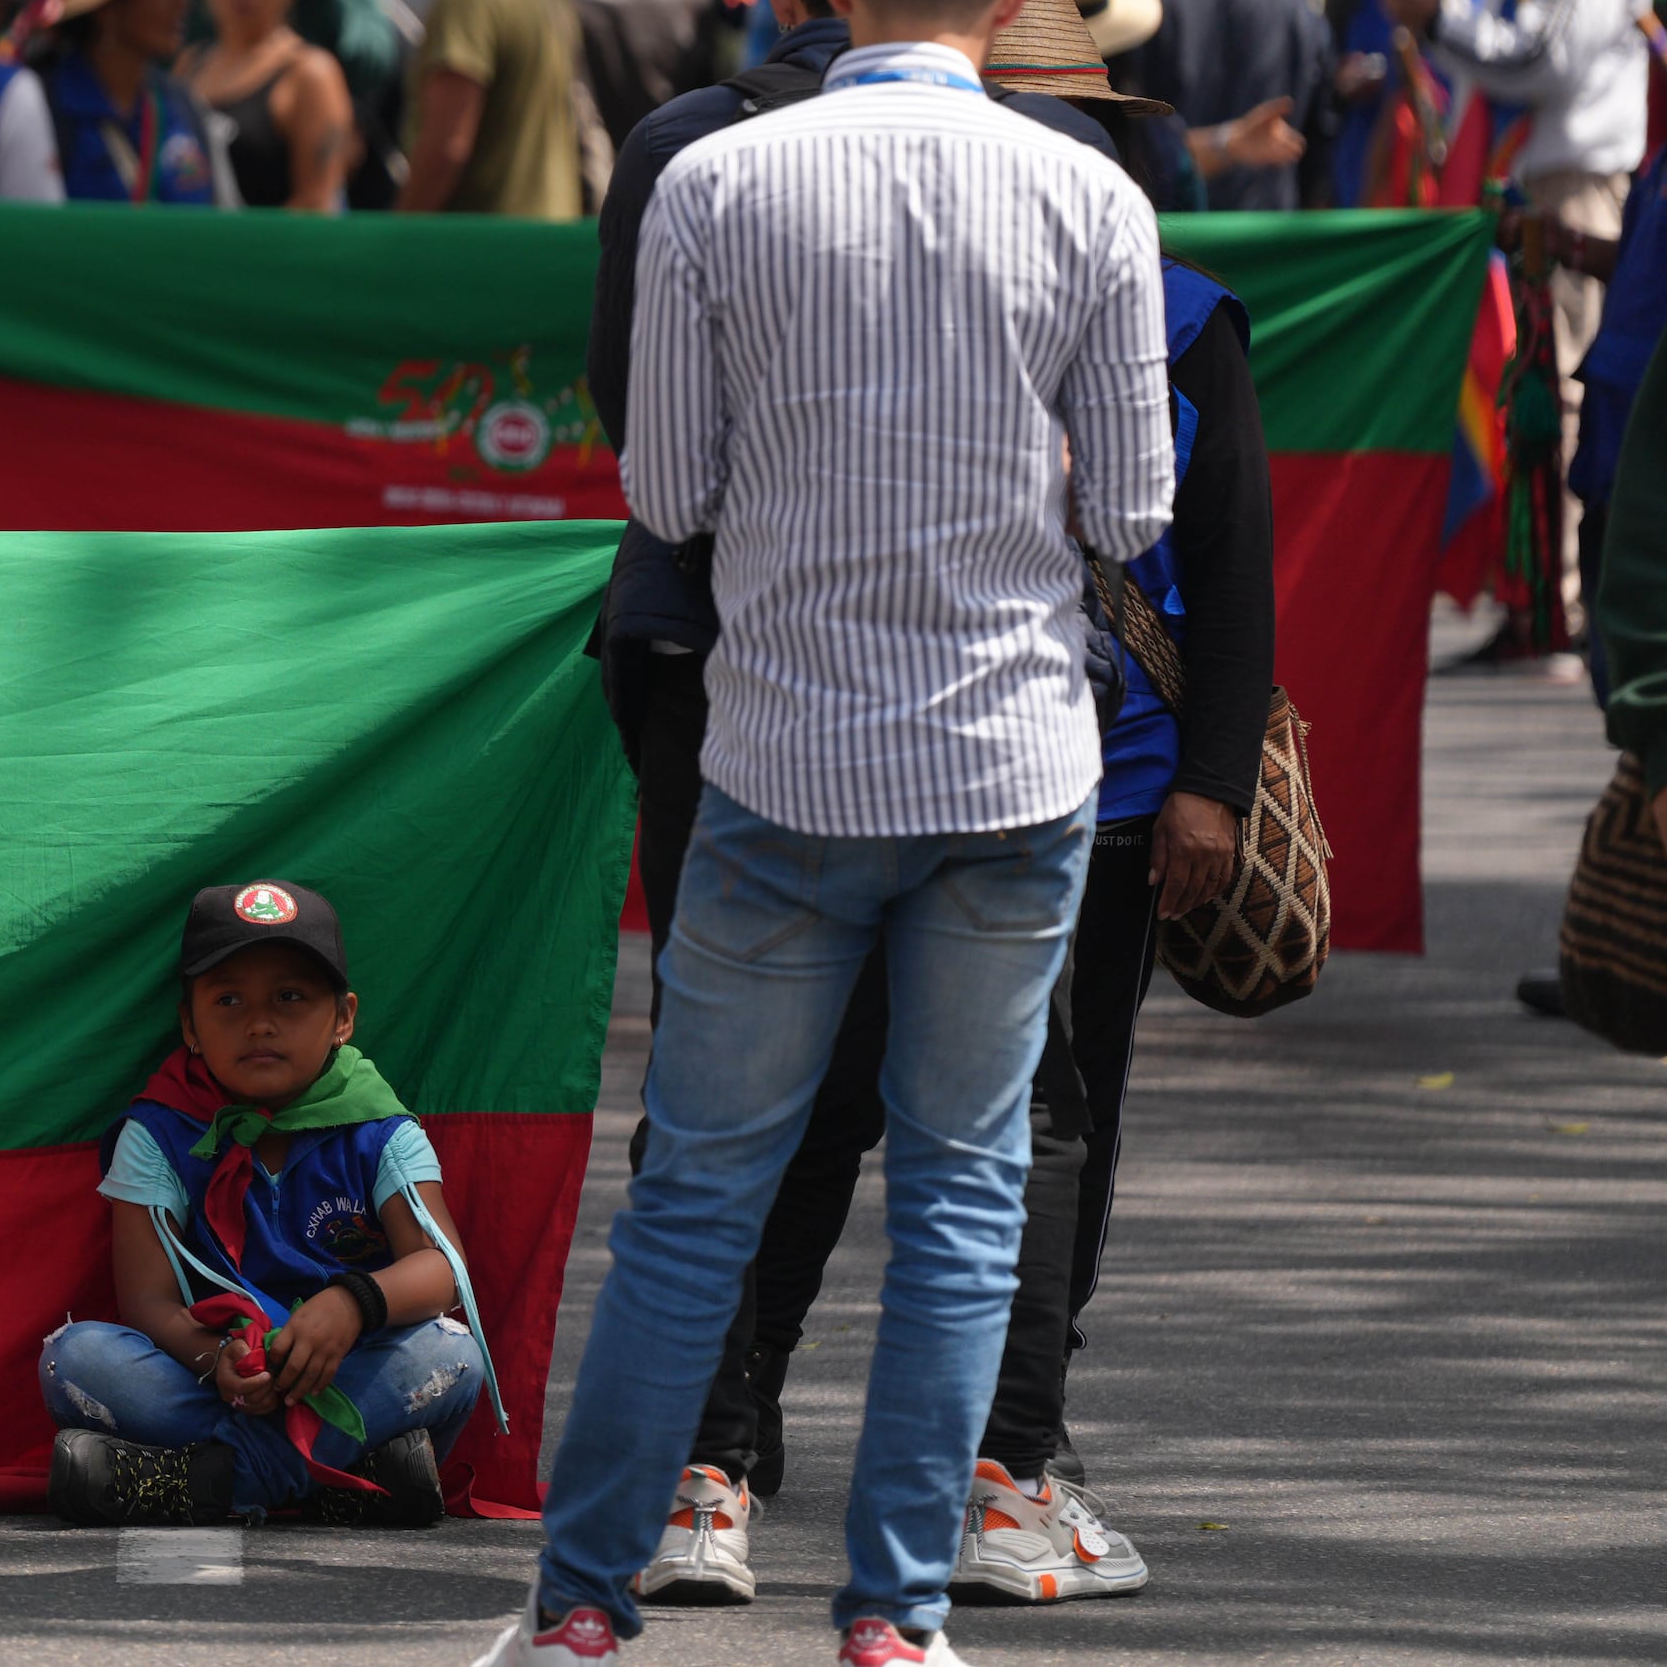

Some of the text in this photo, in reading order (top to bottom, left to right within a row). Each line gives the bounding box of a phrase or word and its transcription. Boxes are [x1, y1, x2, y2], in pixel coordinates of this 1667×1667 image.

[1095, 835, 1115, 846] UST
[1117, 835, 1132, 846] DO
[306, 1200, 333, 1239] CXHAB
